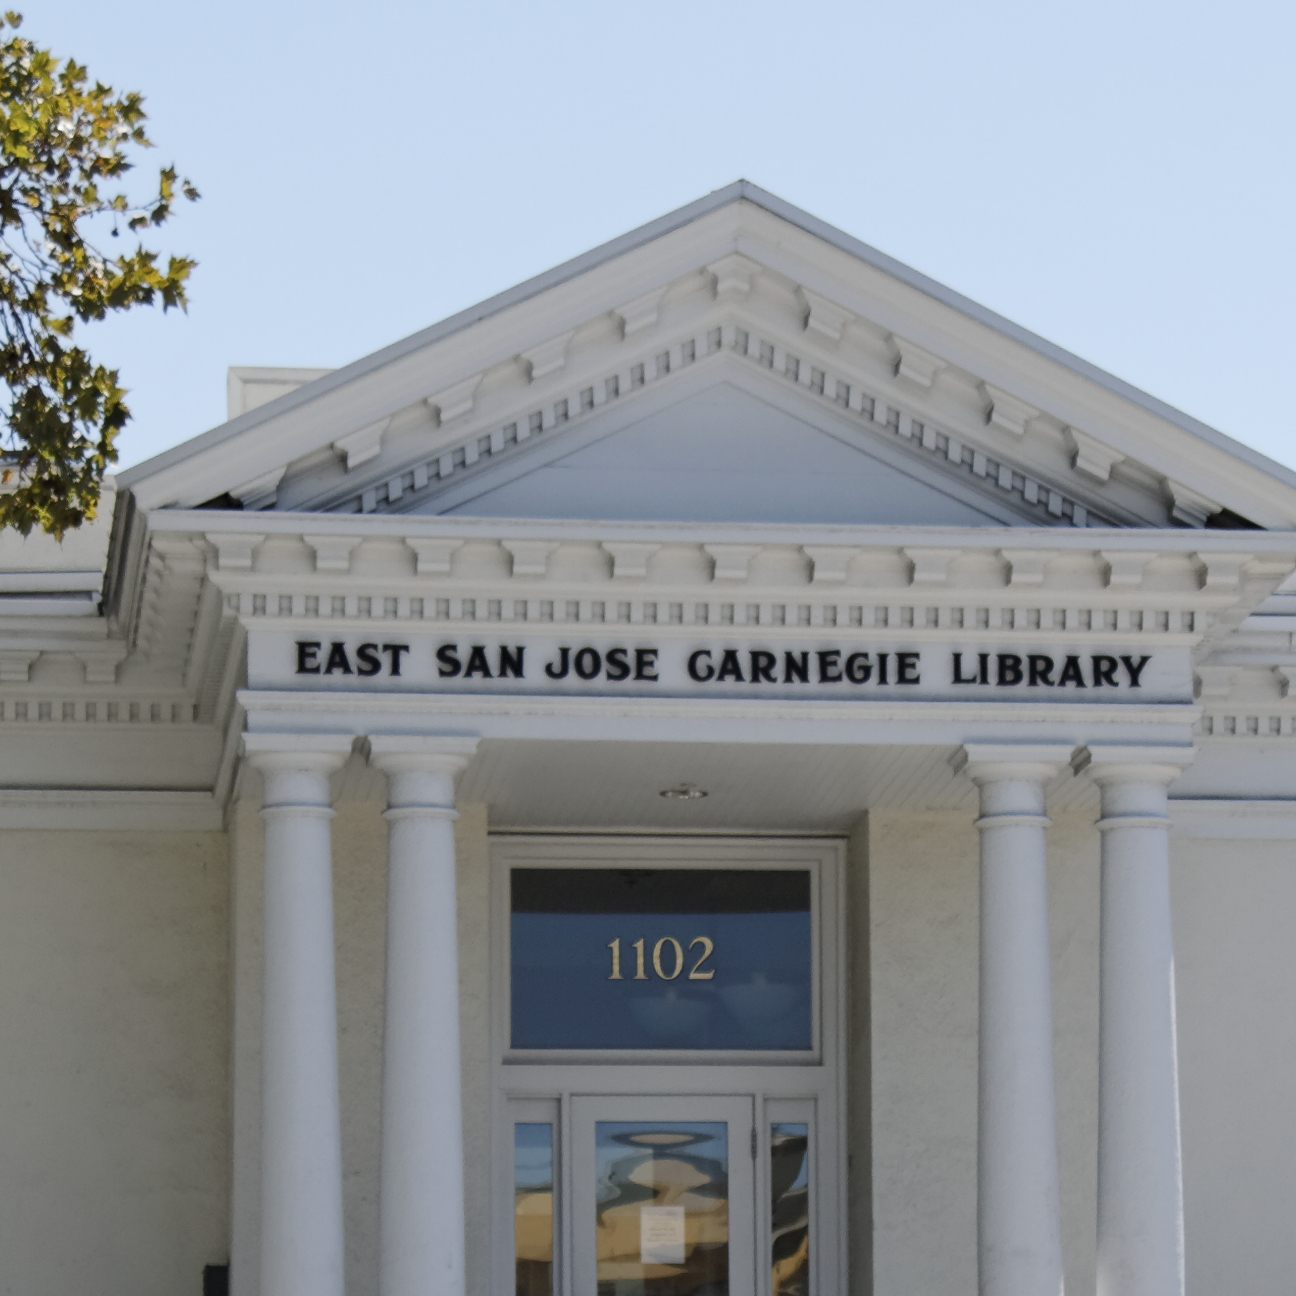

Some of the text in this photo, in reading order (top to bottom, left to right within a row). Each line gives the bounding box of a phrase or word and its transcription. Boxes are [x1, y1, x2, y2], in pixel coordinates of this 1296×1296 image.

[294, 640, 1152, 689] EAST SAN JOSE CARNEGIE LIBRARY
[606, 936, 715, 980] 1102
